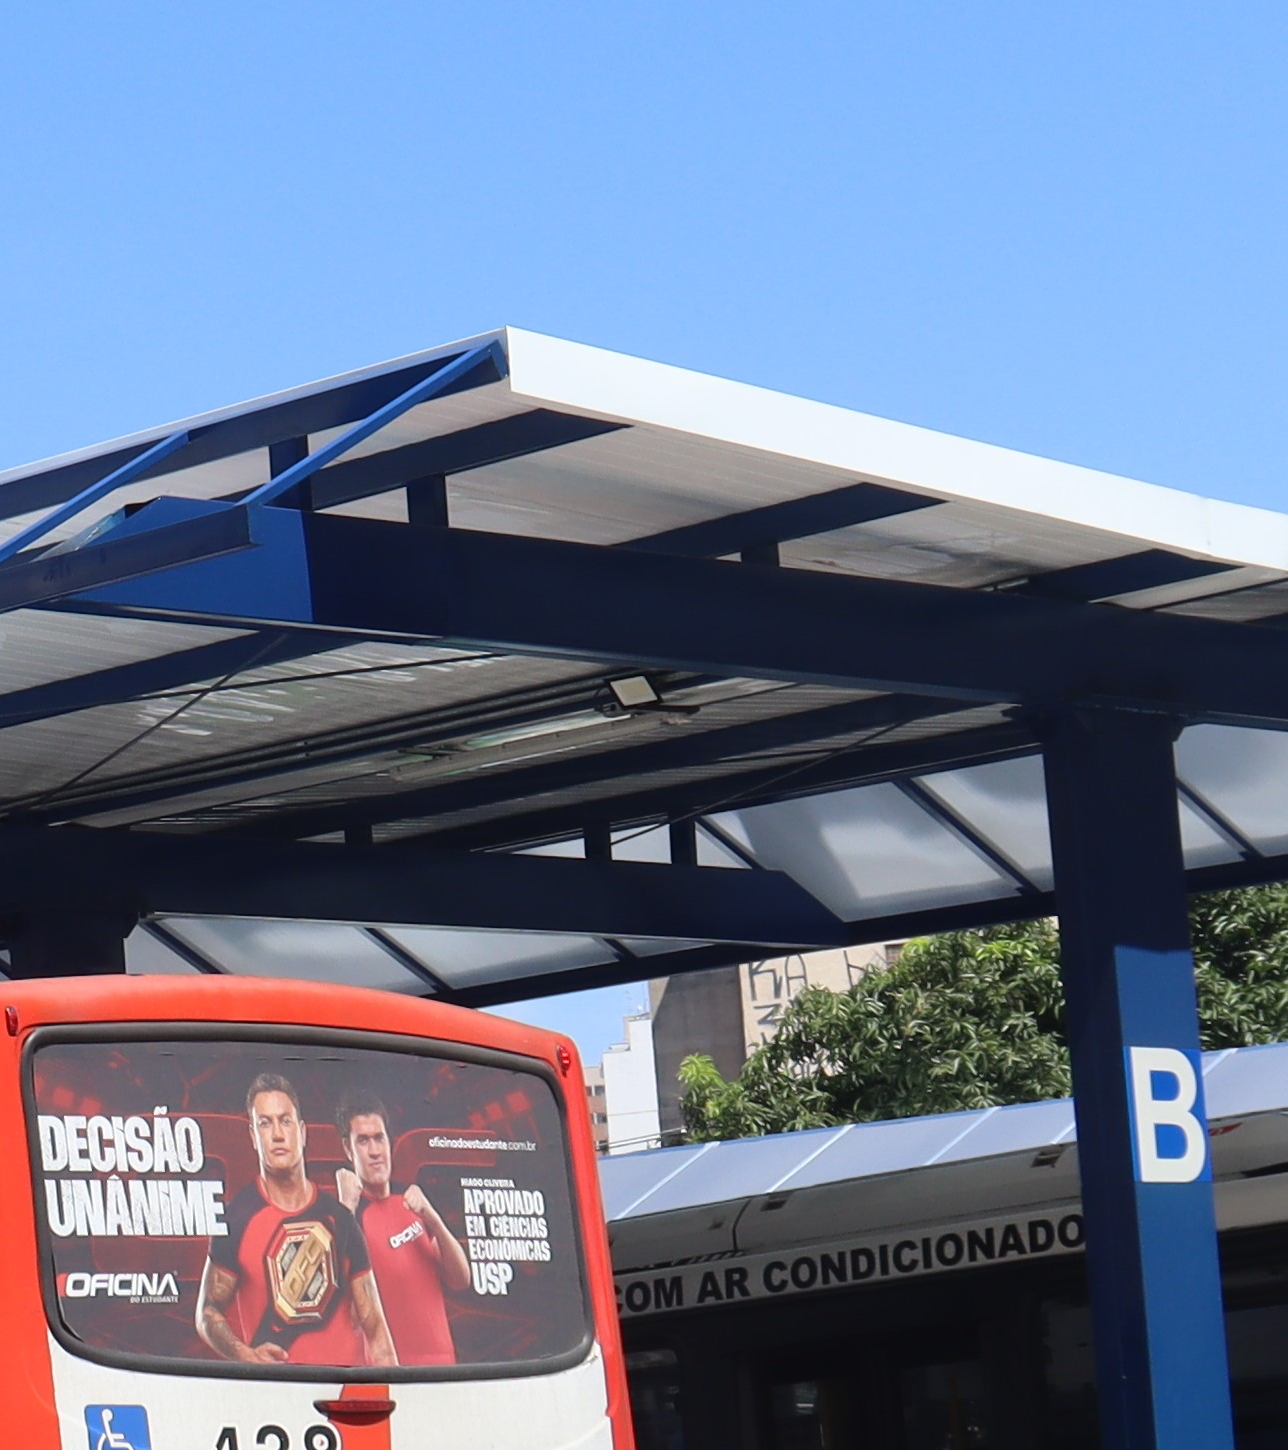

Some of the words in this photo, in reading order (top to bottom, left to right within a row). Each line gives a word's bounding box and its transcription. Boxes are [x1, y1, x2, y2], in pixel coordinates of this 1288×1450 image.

[1130, 1046, 1206, 1183] B
[37, 1105, 204, 1173] DECISÃO
[44, 1174, 229, 1237] UNÂNIME
[463, 1188, 545, 1216] APROVADO
[465, 1215, 486, 1237] EM
[490, 1214, 548, 1238] CIÊNCIAS
[471, 1261, 513, 1295] USP
[696, 1265, 749, 1305] AR
[762, 1213, 1086, 1294] CONDICIONADO
[65, 1272, 179, 1297] OFICINA
